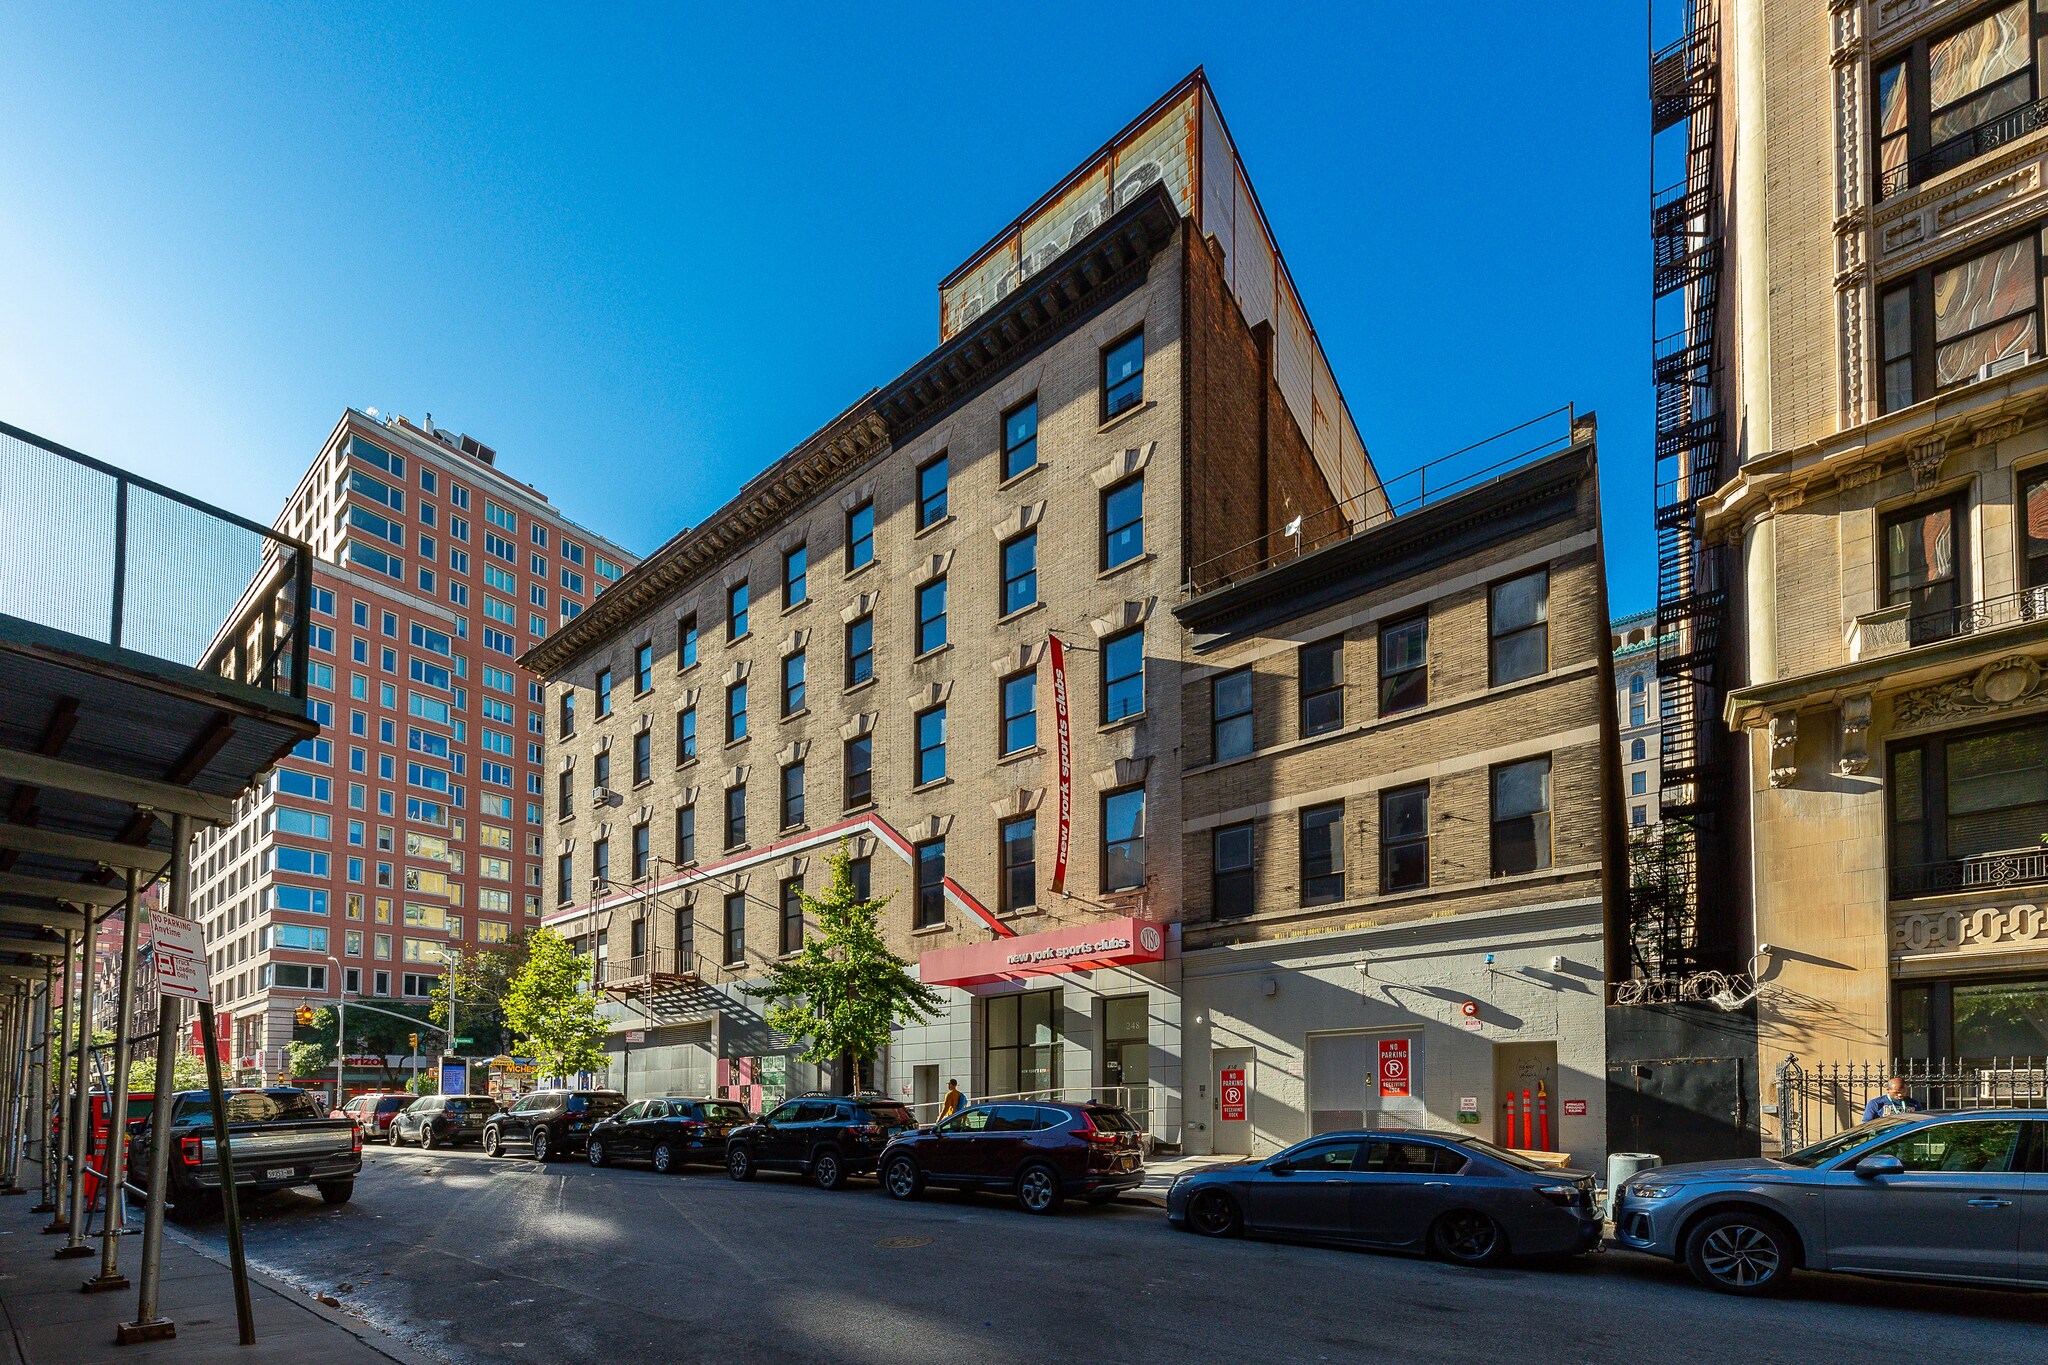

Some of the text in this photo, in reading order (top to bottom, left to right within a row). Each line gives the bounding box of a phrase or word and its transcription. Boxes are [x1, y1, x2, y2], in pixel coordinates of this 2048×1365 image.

[1055, 669, 1070, 864] new york sports clubs
[152, 914, 192, 931] NO PARKING
[154, 924, 181, 937] Anytime
[1007, 937, 1127, 964] new york sports clubs
[176, 965, 196, 975] Loading
[1126, 1022, 1140, 1030] 248
[1389, 1043, 1398, 1051] NO
[1381, 1051, 1407, 1059] PARKING
